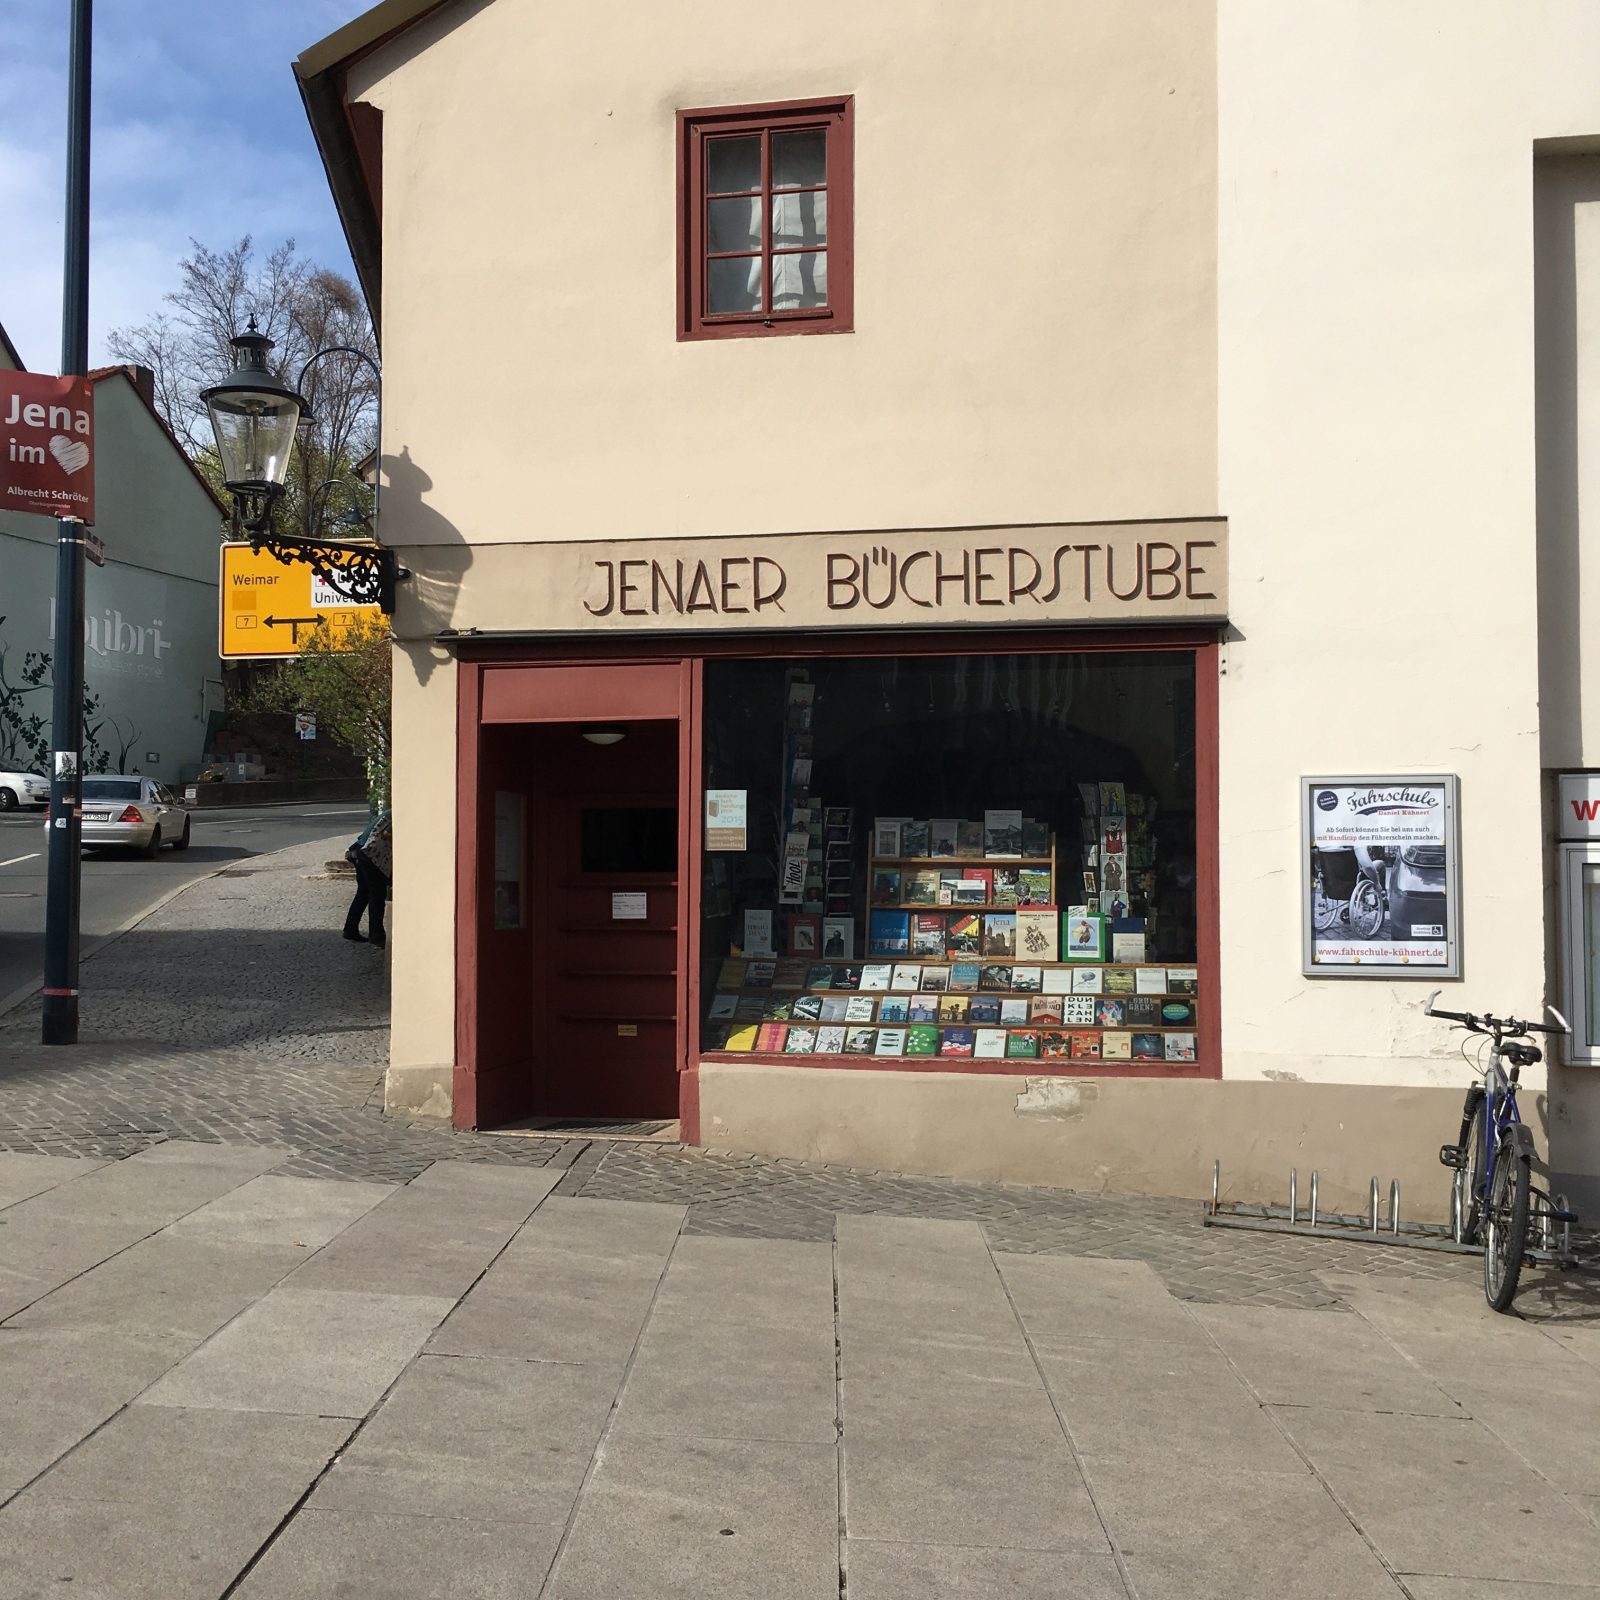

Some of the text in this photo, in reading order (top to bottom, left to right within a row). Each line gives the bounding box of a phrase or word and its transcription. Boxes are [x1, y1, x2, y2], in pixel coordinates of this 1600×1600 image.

[5, 394, 90, 436] Jena
[9, 437, 45, 465] im
[7, 486, 89, 503] Albrecht Schröter
[233, 574, 280, 586] Weimar
[583, 540, 1218, 617] JENAER BÜCHERSTUBE
[243, 617, 250, 627] 7
[341, 614, 347, 624] 7
[1347, 787, 1439, 811] Fahrschule
[1355, 826, 1379, 834] können
[1380, 826, 1390, 834] Sie
[1414, 825, 1430, 833] auch
[1371, 833, 1412, 842] Führerschein
[993, 917, 1010, 926] Jena
[1318, 947, 1443, 957] www.fahrschule-kühnert.de
